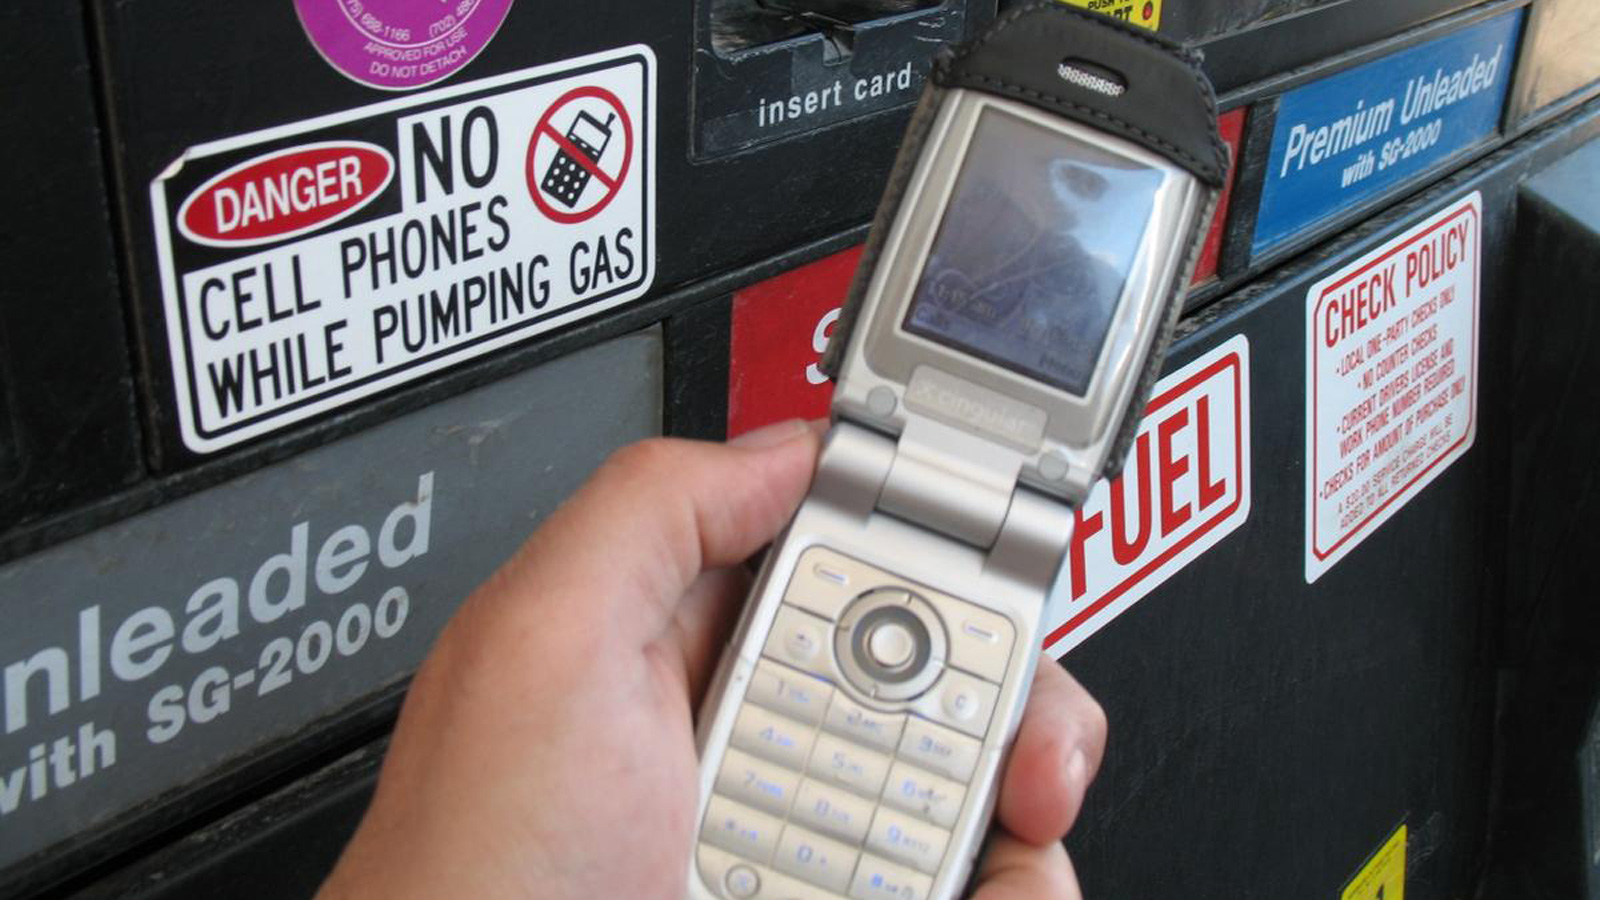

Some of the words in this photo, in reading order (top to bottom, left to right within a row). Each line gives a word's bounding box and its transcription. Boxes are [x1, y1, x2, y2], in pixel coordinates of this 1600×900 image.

[364, 41, 421, 60] APPROVED
[423, 41, 445, 56] FOR
[446, 27, 467, 46] USE
[370, 61, 390, 76] DO
[392, 65, 418, 78] NOT
[420, 46, 467, 75] DETACH
[759, 81, 842, 127] insert
[854, 62, 912, 100] card
[1280, 98, 1395, 178] Premium
[1401, 44, 1502, 125] Unleaded
[214, 156, 364, 233] DANGER
[412, 105, 499, 203] NO
[1341, 153, 1375, 188] with
[1378, 119, 1442, 170] SG-2000
[202, 254, 321, 341] CELL
[340, 195, 511, 298] PHONES
[1325, 263, 1396, 348] CHECK
[1406, 218, 1469, 298] POLICY
[1412, 297, 1437, 328] CHECKS
[208, 319, 352, 419] WHILE
[373, 254, 550, 364] PUMPING
[569, 228, 634, 295] GAS
[1376, 343, 1408, 381] COUNTER
[1412, 323, 1437, 356] CHECKS
[1340, 428, 1363, 458] WORK
[1366, 406, 1389, 438] PHONE
[1392, 383, 1421, 418] NUMBER
[1424, 358, 1455, 395] REQUIRED
[1357, 449, 1370, 472] FOR
[1373, 422, 1403, 458] AMOUNT
[1405, 414, 1414, 435] OF
[1416, 388, 1449, 425] PURCHASE
[1451, 376, 1466, 398] ONLY
[1379, 370, 1409, 407] DRIVERS
[1412, 349, 1438, 383] LICENSE
[1069, 394, 1226, 602] FUEL
[147, 586, 409, 744] SG-2000
